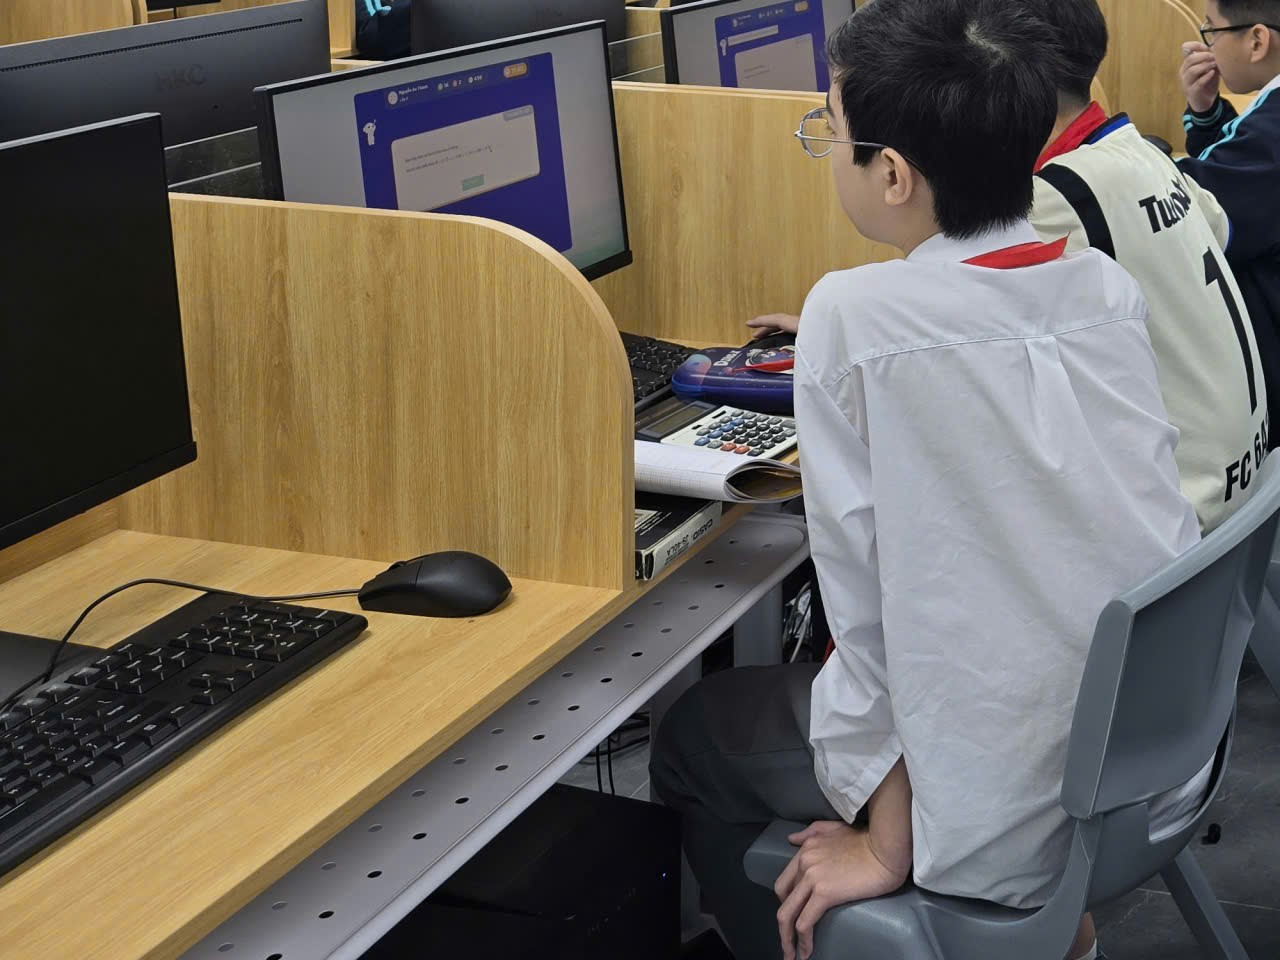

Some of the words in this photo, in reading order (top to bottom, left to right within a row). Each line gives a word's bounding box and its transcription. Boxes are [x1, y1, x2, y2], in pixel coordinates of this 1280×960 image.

[1202, 246, 1257, 416] 1
[1224, 450, 1251, 503] FC
[693, 519, 713, 541] CASIO
